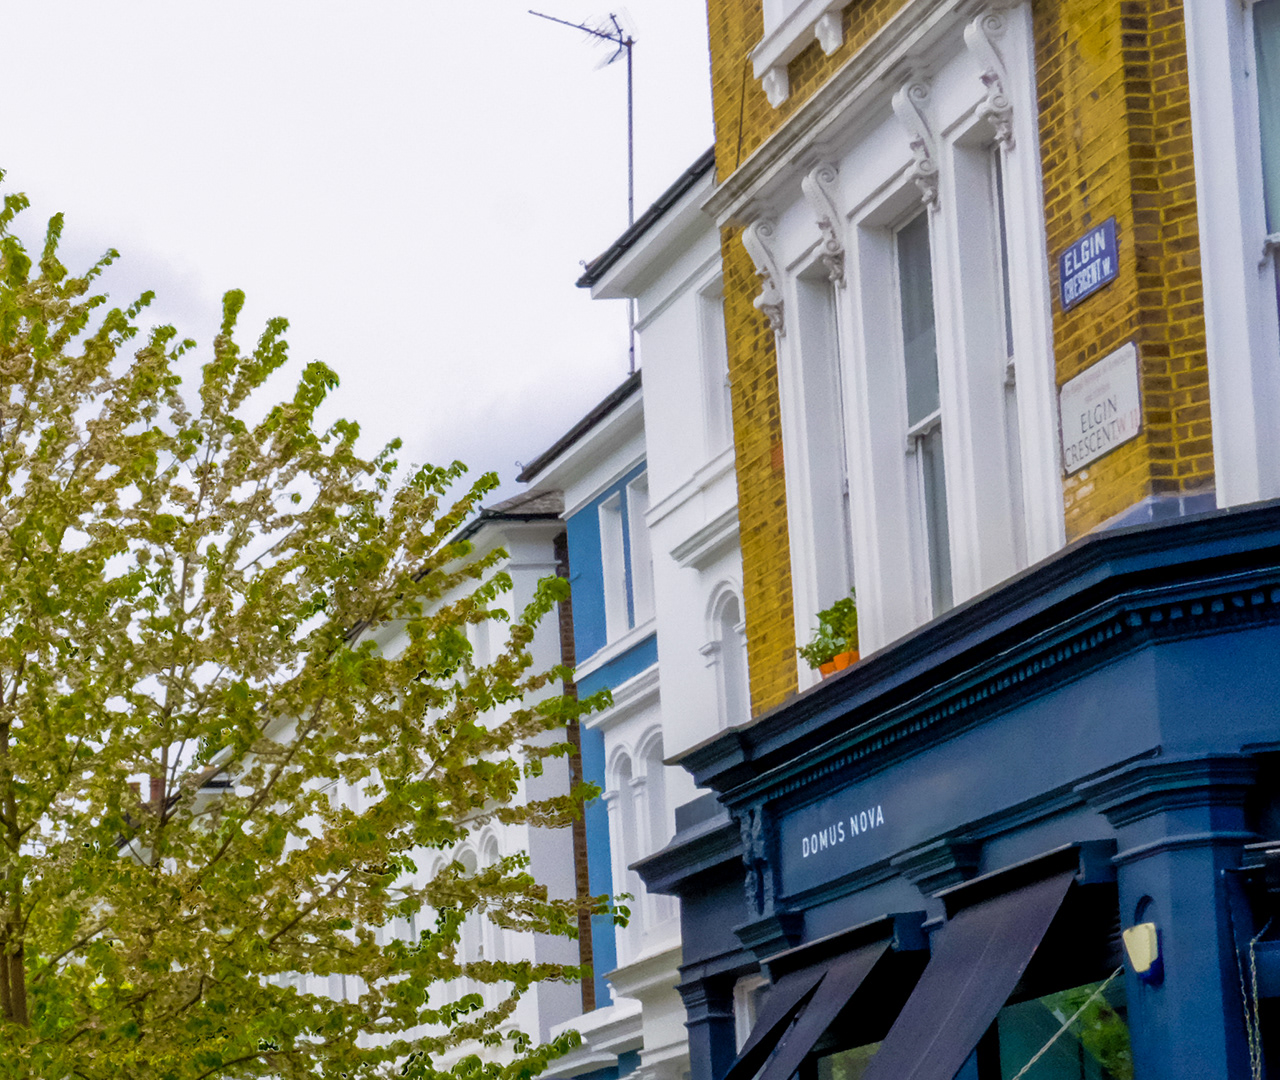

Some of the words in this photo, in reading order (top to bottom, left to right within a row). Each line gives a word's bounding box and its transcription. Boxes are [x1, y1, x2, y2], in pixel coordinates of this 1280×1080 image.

[1064, 228, 1106, 277] ELGIN
[1080, 394, 1117, 434] ELGIN
[802, 821, 845, 858] DOMUS
[850, 805, 884, 837] NOVA
